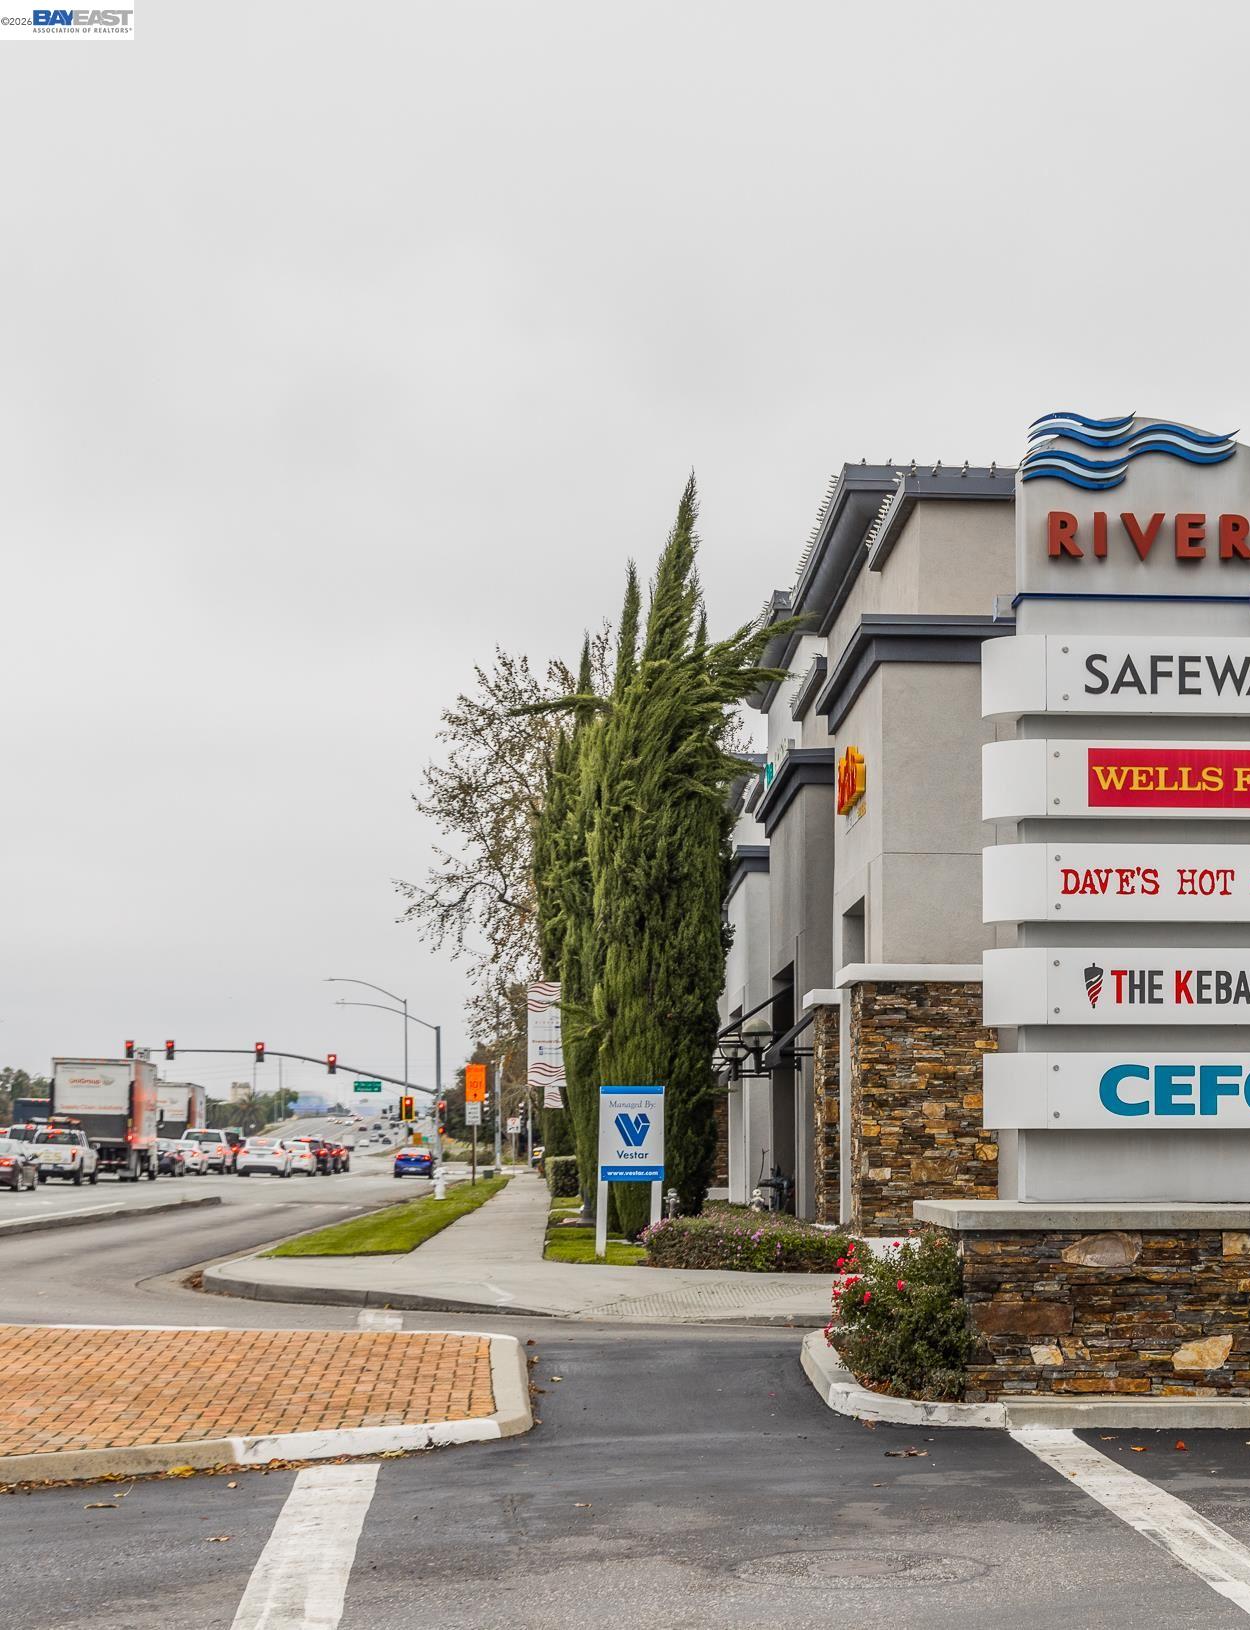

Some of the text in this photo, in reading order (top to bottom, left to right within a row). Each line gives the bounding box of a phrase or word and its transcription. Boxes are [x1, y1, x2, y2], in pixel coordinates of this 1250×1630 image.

[1092, 766, 1224, 793] WELLS
[1060, 867, 1160, 895] DAVE'S
[1177, 869, 1235, 895] HOT
[1111, 970, 1164, 1004] THE
[608, 1099, 643, 1110] Managed
[616, 1149, 650, 1160] Vestar
[606, 1169, 659, 1177] www.vestar.com
